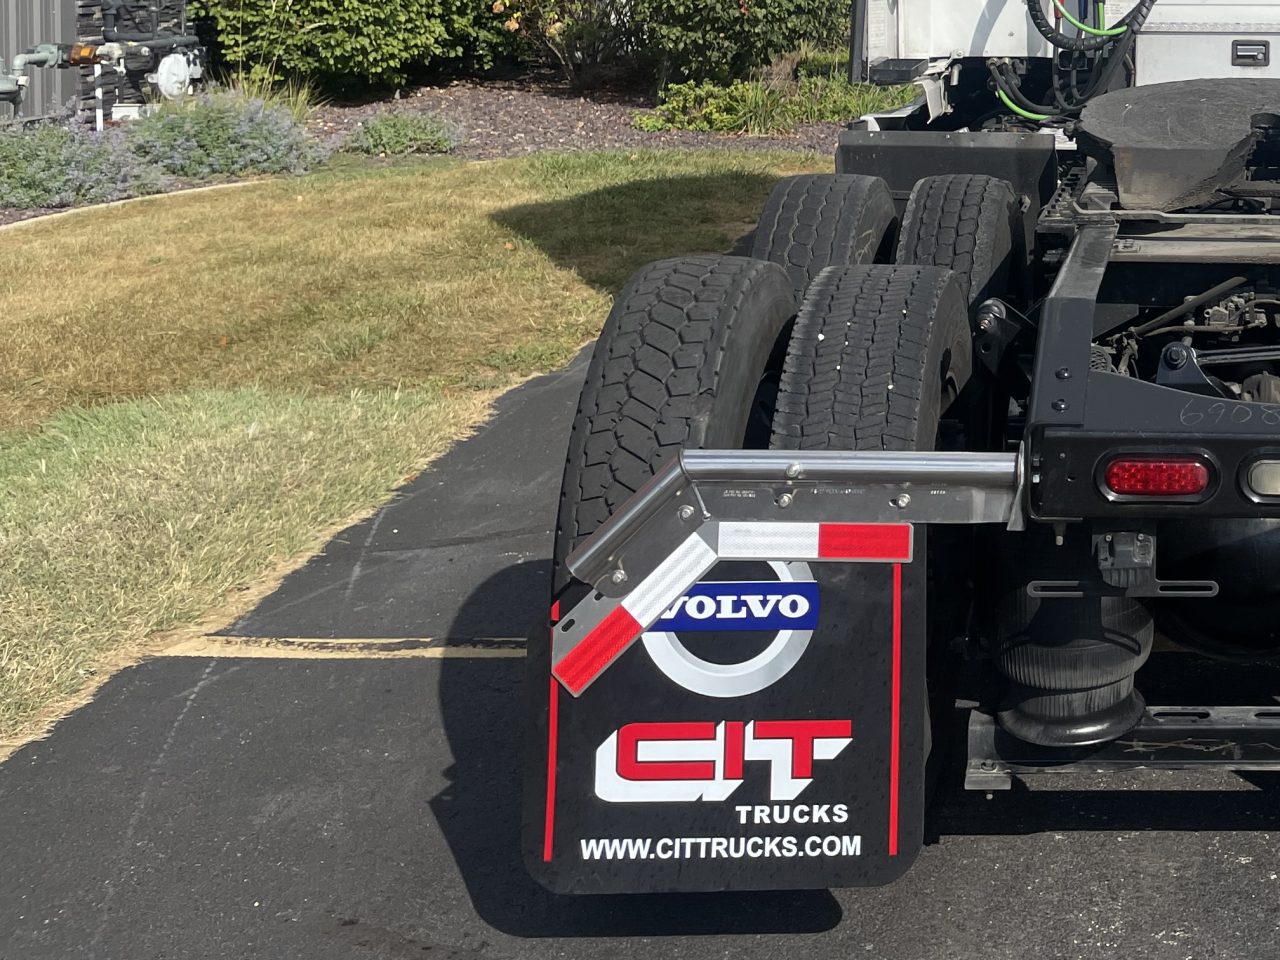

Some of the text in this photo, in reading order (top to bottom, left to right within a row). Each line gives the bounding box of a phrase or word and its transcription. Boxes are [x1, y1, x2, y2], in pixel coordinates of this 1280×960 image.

[595, 719, 853, 802] CIT
[735, 804, 849, 824] TRUCKS
[580, 835, 862, 860] WWW.CITTRUCKS.COM
